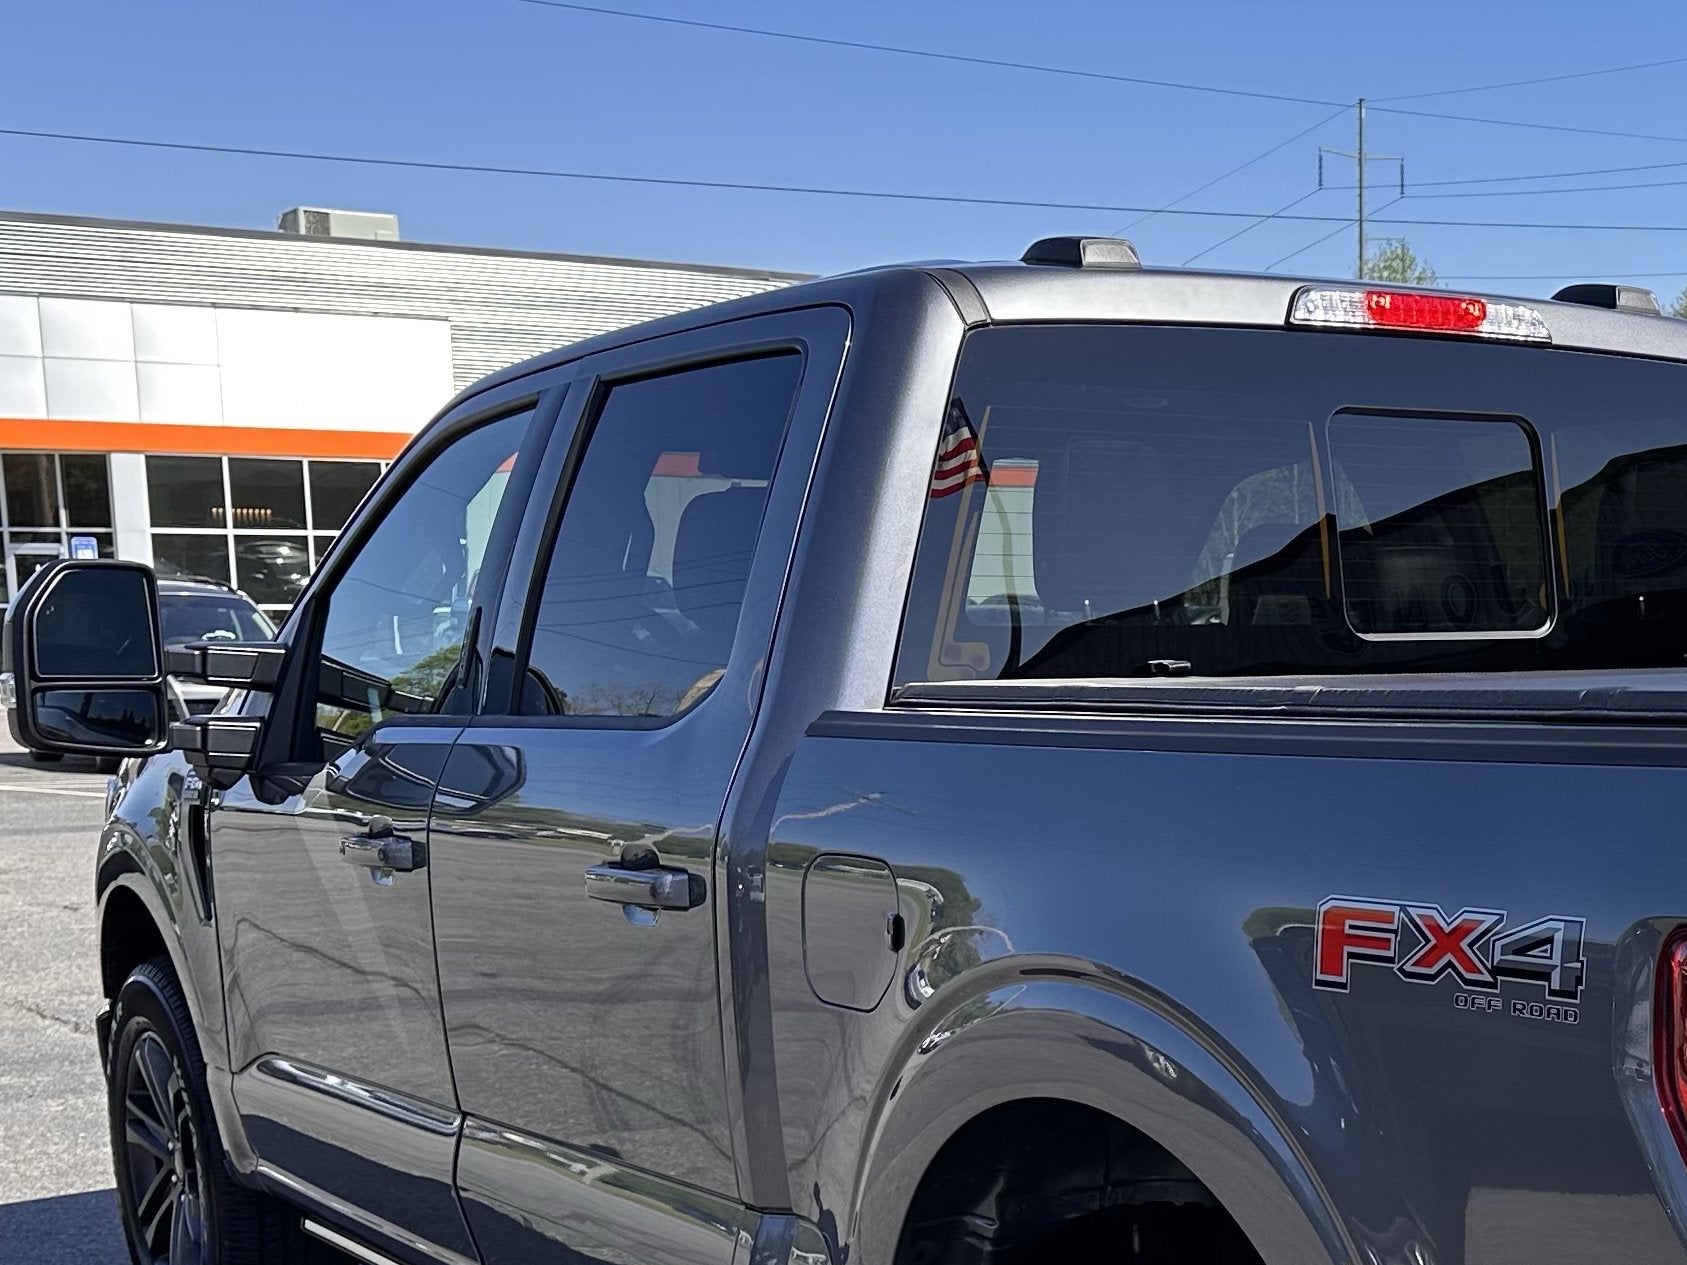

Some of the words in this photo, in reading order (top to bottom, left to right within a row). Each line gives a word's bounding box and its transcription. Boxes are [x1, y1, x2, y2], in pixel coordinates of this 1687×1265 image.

[1312, 894, 1586, 1003] FX4
[1453, 992, 1502, 1012] OFF
[1511, 999, 1580, 1024] ROAD
